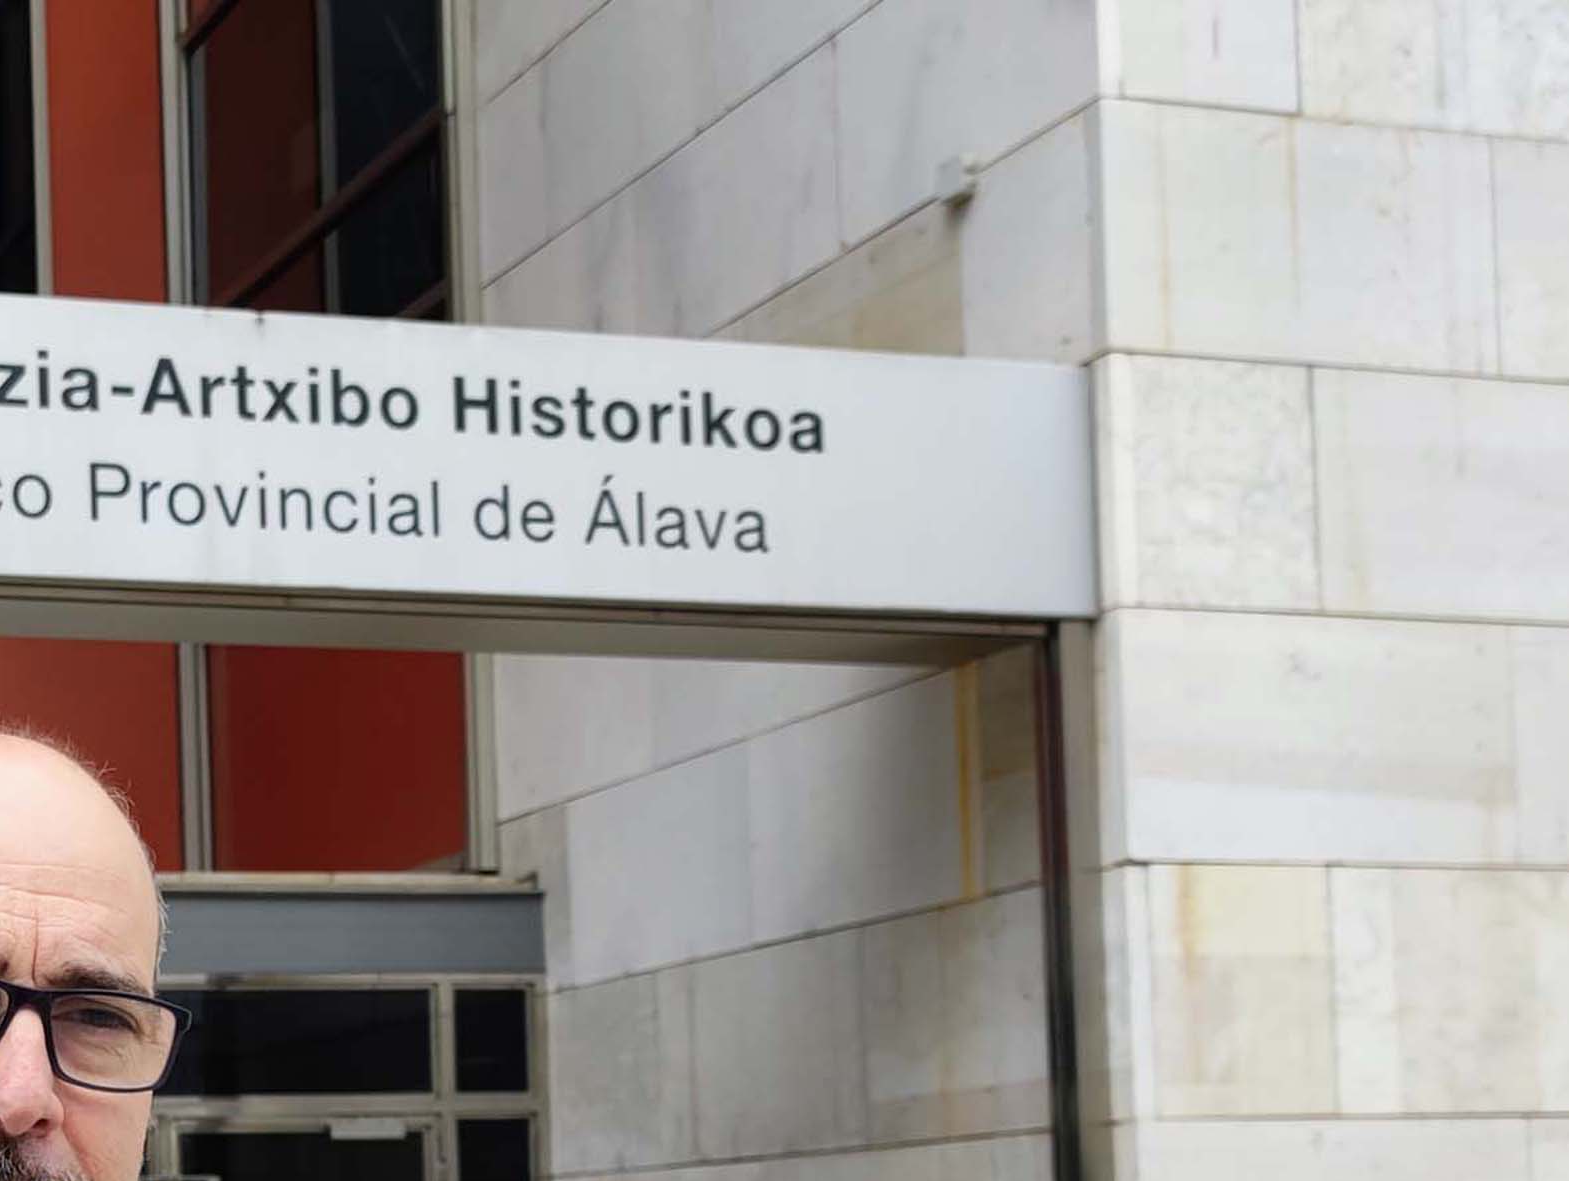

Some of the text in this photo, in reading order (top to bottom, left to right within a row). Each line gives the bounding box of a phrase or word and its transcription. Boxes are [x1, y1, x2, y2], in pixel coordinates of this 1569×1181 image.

[453, 376, 824, 453] Historikoa
[89, 462, 440, 537] Provincial
[473, 485, 555, 542] de
[584, 475, 769, 553] Álava
